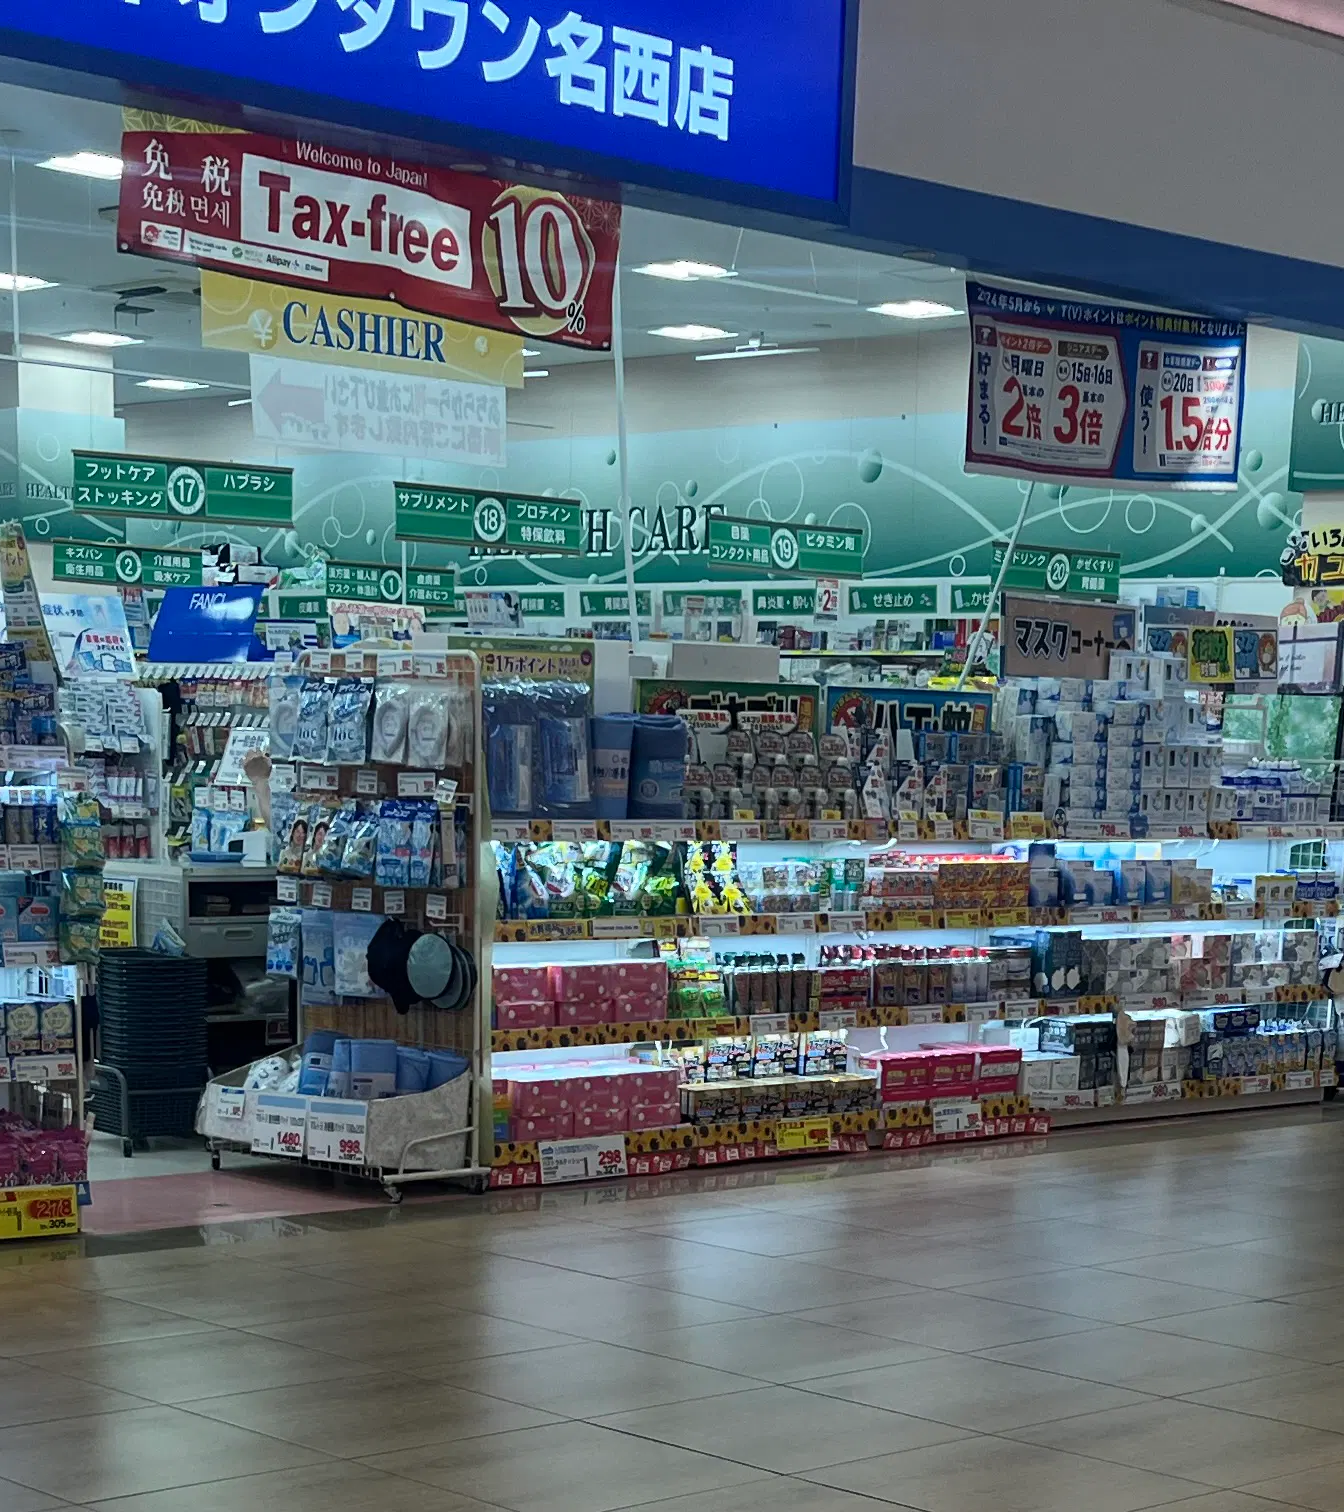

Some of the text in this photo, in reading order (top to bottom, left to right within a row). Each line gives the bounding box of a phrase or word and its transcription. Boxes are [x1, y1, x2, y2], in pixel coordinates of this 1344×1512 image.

[124, 0, 735, 142] タウン名西店
[296, 140, 363, 172] Welcome
[367, 157, 382, 174] to
[190, 195, 231, 229] 면세
[258, 171, 460, 272] Tax-free
[488, 198, 590, 334] 10 %
[283, 301, 446, 363] CASHIER
[1010, 354, 1045, 378] 月曜日
[1172, 372, 1194, 393] 20日
[1001, 375, 1025, 437] 2
[1053, 384, 1081, 445] 3
[1026, 403, 1042, 441] 倍
[1079, 408, 1104, 446] 倍
[1160, 395, 1204, 452] 1.5
[85, 462, 156, 483] フットケア
[223, 473, 276, 493] ハブラシ
[77, 485, 164, 508] ストッキング
[175, 476, 196, 504] 17
[398, 492, 470, 514] サプリメント
[516, 503, 572, 523] プロテイン
[481, 507, 499, 532] 18
[520, 525, 567, 545] 特保飲料
[805, 533, 856, 551] ビタミン剤
[711, 544, 770, 564] コンタクト用品
[777, 537, 791, 558] 19
[64, 562, 105, 578] 衛生用品
[123, 557, 134, 575] 2
[1050, 560, 1066, 581] 20
[1075, 558, 1114, 574] かぜぐすり
[153, 570, 191, 584] 吸水ケア
[387, 577, 395, 594] 1
[757, 595, 815, 611] 鼻炎薬・酔い
[872, 593, 915, 608] せき止め
